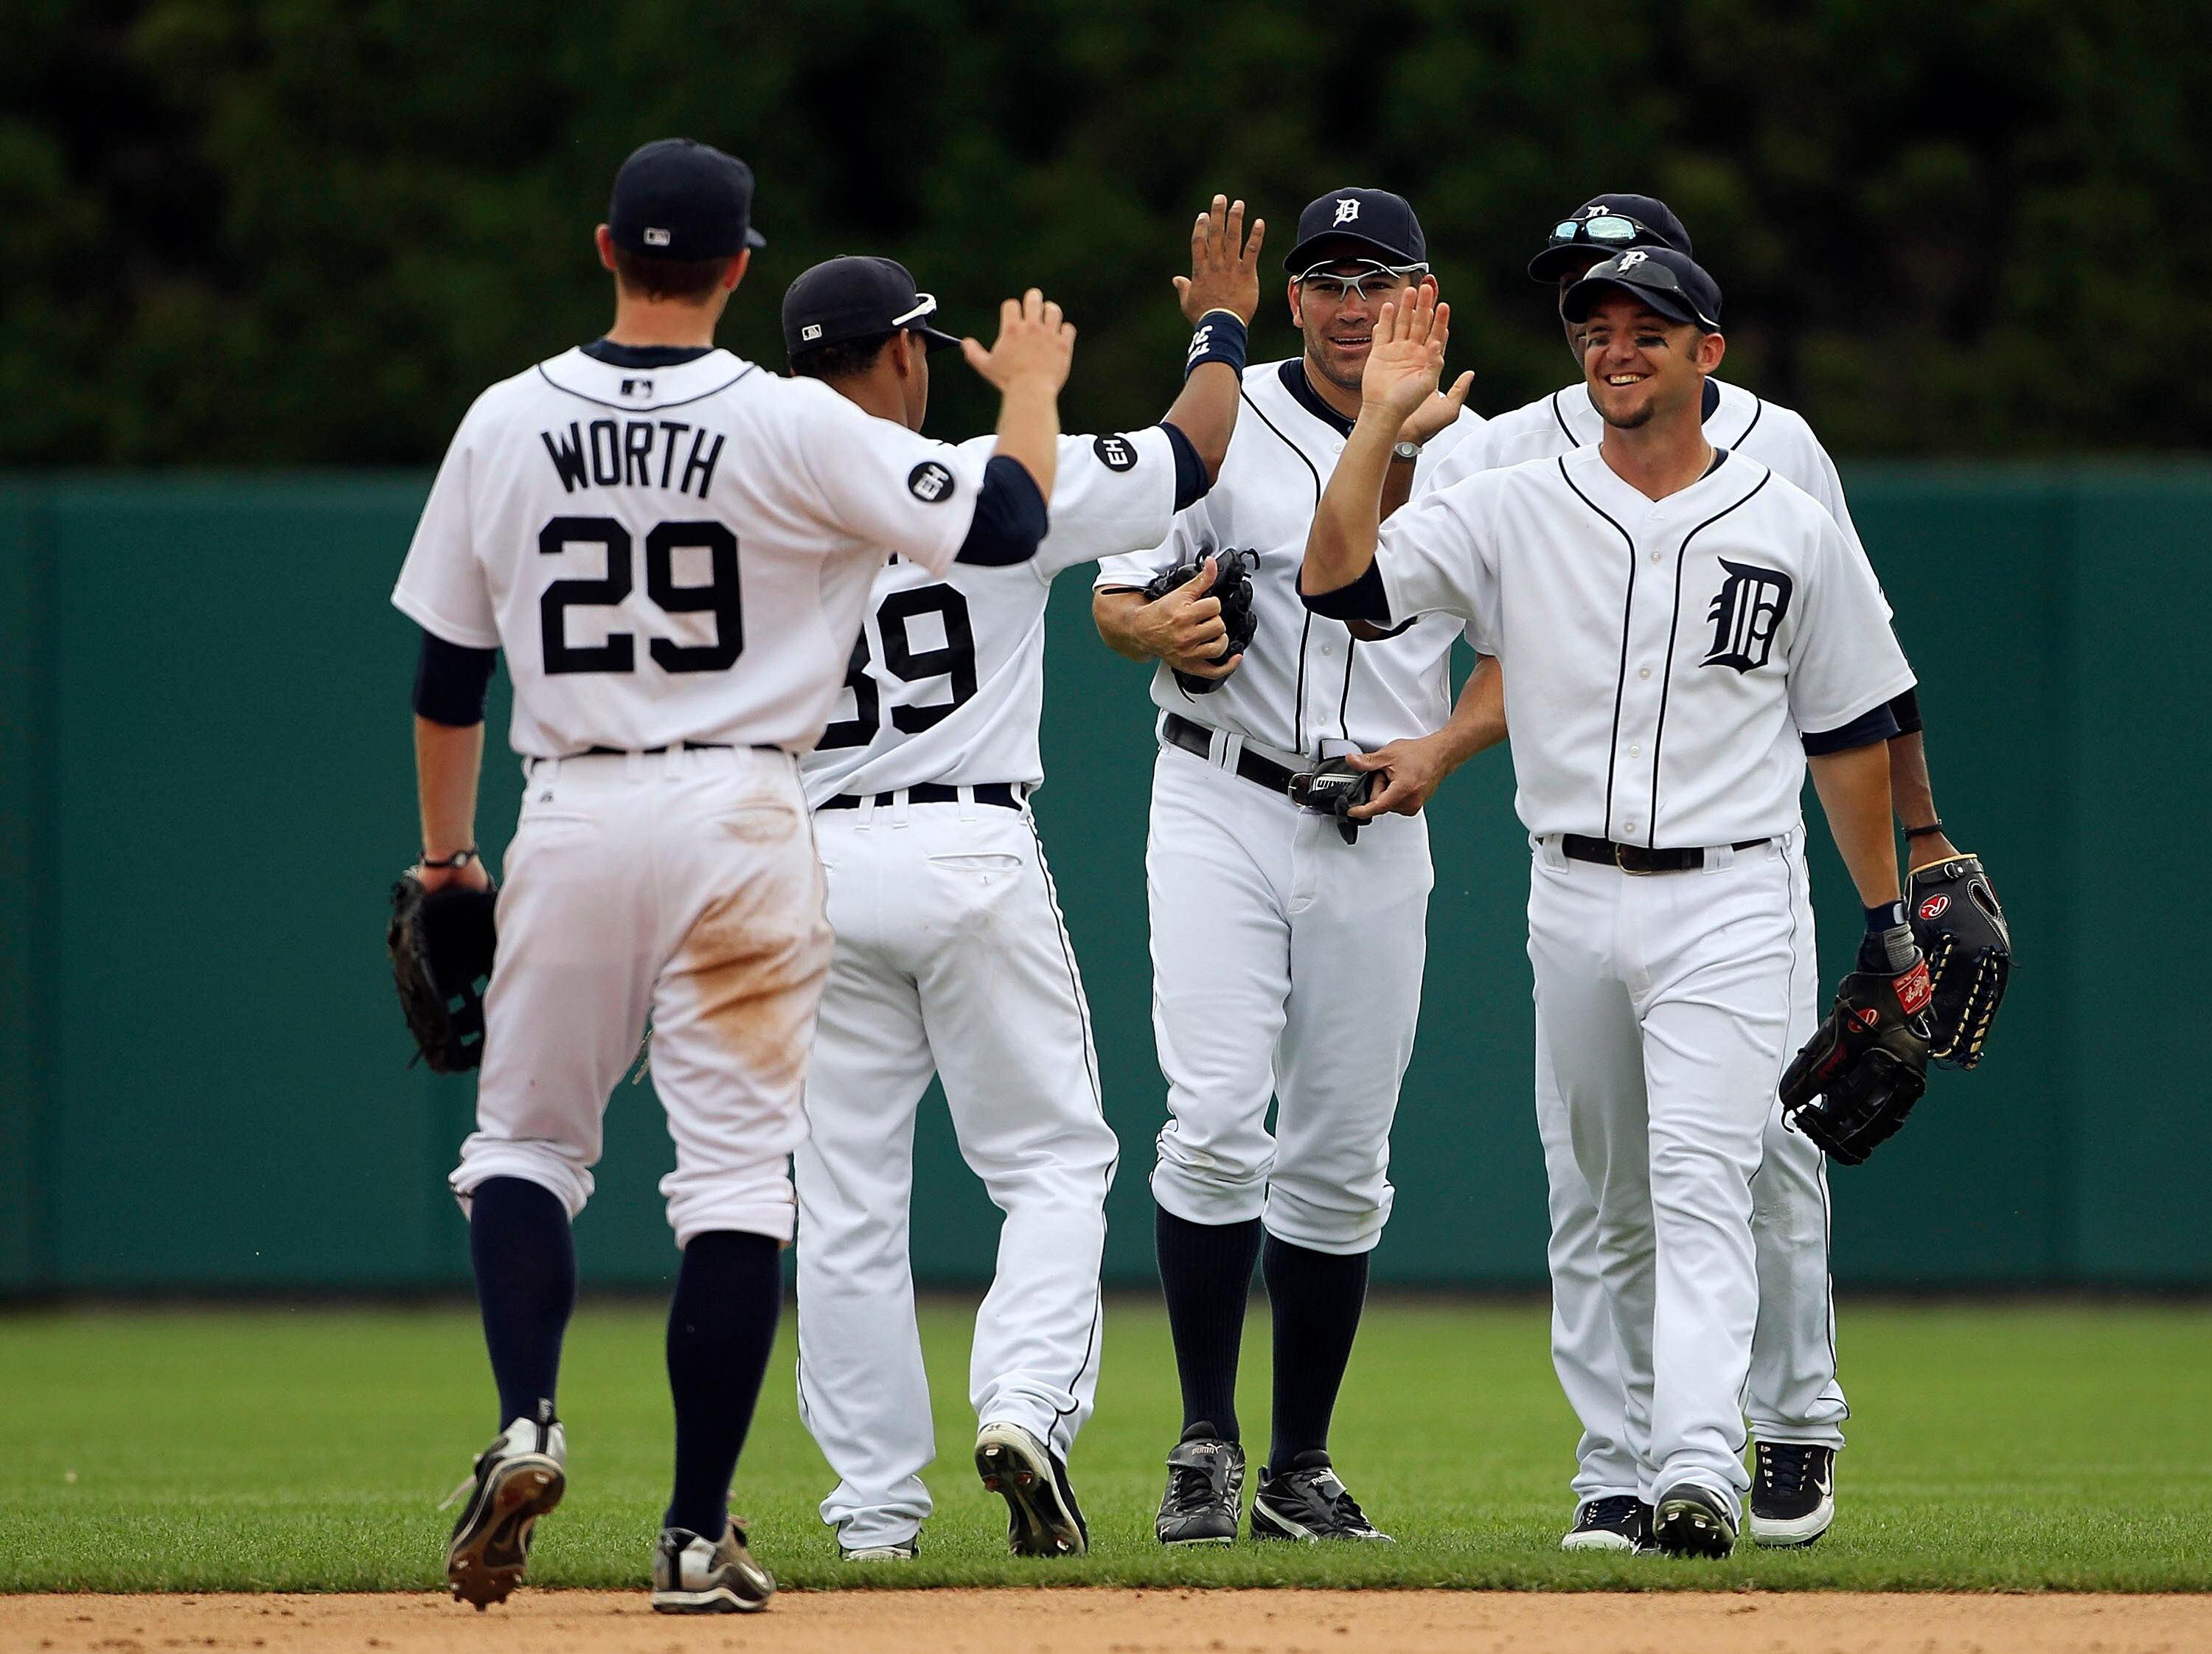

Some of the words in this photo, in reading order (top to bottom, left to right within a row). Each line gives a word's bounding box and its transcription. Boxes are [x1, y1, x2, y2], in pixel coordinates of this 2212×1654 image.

[1333, 198, 1361, 228] D
[540, 420, 726, 498] WORTH
[1103, 439, 1129, 465] EH
[913, 464, 950, 501] EH
[538, 516, 744, 675] 29
[1698, 555, 1793, 675] D
[1191, 1445, 1215, 1456] PUMA
